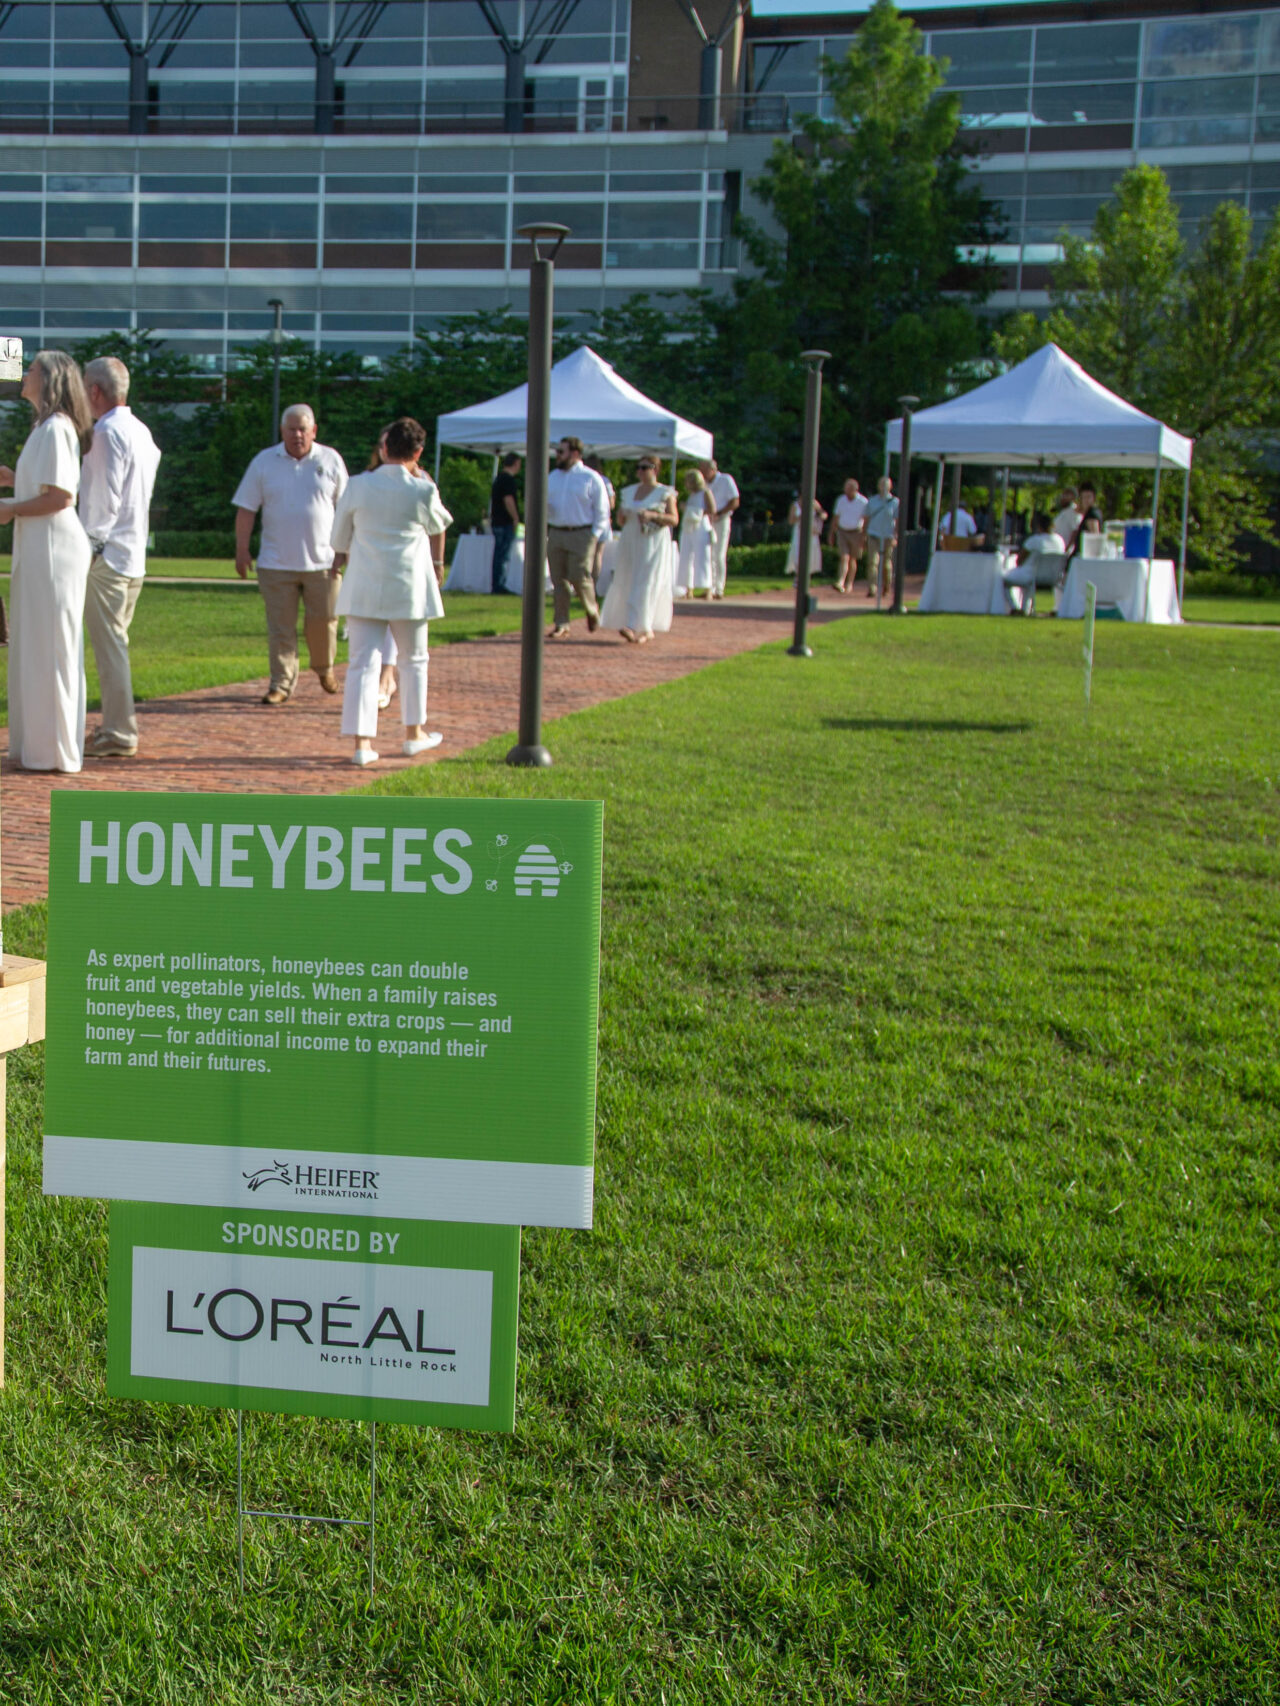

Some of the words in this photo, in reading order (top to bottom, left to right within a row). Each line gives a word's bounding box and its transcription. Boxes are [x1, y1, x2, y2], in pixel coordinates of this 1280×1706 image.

[79, 821, 472, 894] HONEYBEES
[87, 949, 107, 966] As
[113, 953, 165, 971] expert
[171, 952, 265, 975] pollinators,
[272, 956, 365, 978] honeybees
[371, 963, 402, 977] can
[409, 961, 468, 980] double
[86, 973, 120, 991] fruit
[125, 976, 155, 992] and
[161, 979, 243, 998] vegetable
[250, 980, 305, 1001] yields.
[312, 982, 361, 1001] When
[368, 989, 377, 1002] a
[384, 985, 437, 1008] family
[444, 988, 497, 1006] raises
[87, 998, 180, 1021] honeybees,
[186, 1003, 222, 1024] they
[228, 1008, 258, 1022] can
[265, 1007, 295, 1023] sell
[301, 1008, 341, 1025] their
[347, 1011, 389, 1028] extra
[397, 1015, 445, 1033] crops
[479, 1016, 511, 1033] and
[86, 1023, 135, 1045] honey
[167, 1026, 190, 1044] for
[195, 1028, 279, 1048] additional
[287, 1031, 349, 1051] income
[355, 1036, 371, 1052] to
[378, 1038, 440, 1058] expand
[446, 1039, 488, 1057] their
[85, 1047, 121, 1065] farm
[128, 1050, 158, 1067] and
[163, 1051, 202, 1069] their
[208, 1053, 271, 1072] futures.
[296, 1188, 378, 1199] INTERNATIONAL
[222, 1222, 359, 1251] SPONSORED
[370, 1232, 400, 1254] BY
[166, 1288, 456, 1355] L'ORÉAL
[321, 1353, 361, 1364] North
[371, 1357, 412, 1368] Little
[421, 1361, 456, 1372] Rock
